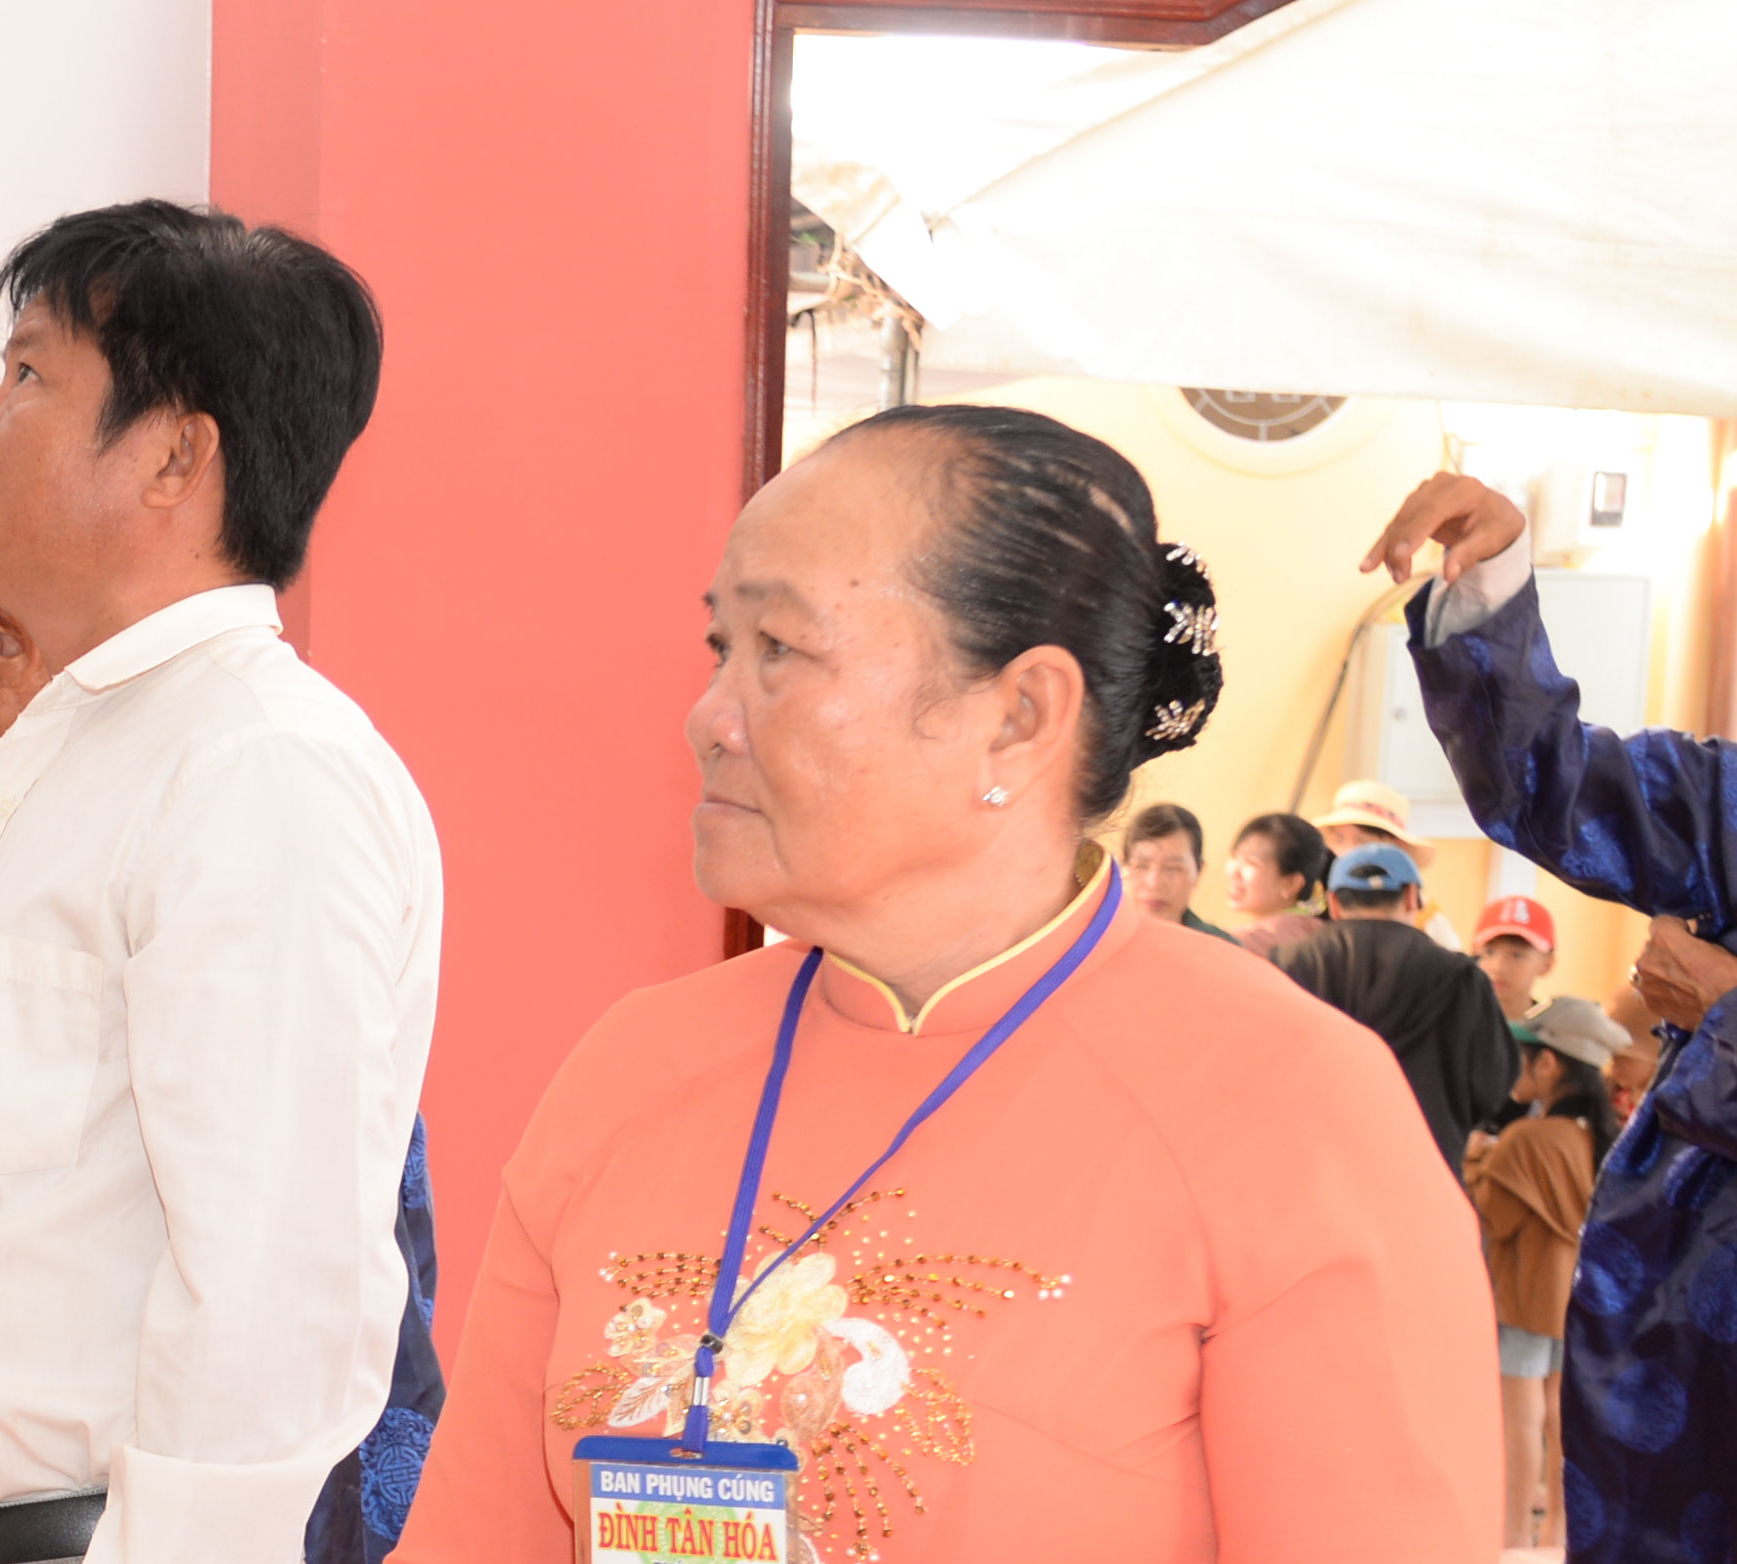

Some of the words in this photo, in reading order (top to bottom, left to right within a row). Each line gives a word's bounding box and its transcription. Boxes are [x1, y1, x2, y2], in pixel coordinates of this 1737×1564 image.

[600, 1471, 641, 1494] BAN
[646, 1473, 713, 1501] PHỤNG
[718, 1474, 774, 1502] CÚNG
[597, 1502, 658, 1553] ĐÌNH
[665, 1508, 714, 1557] TÂN
[722, 1511, 778, 1562] HÓA
